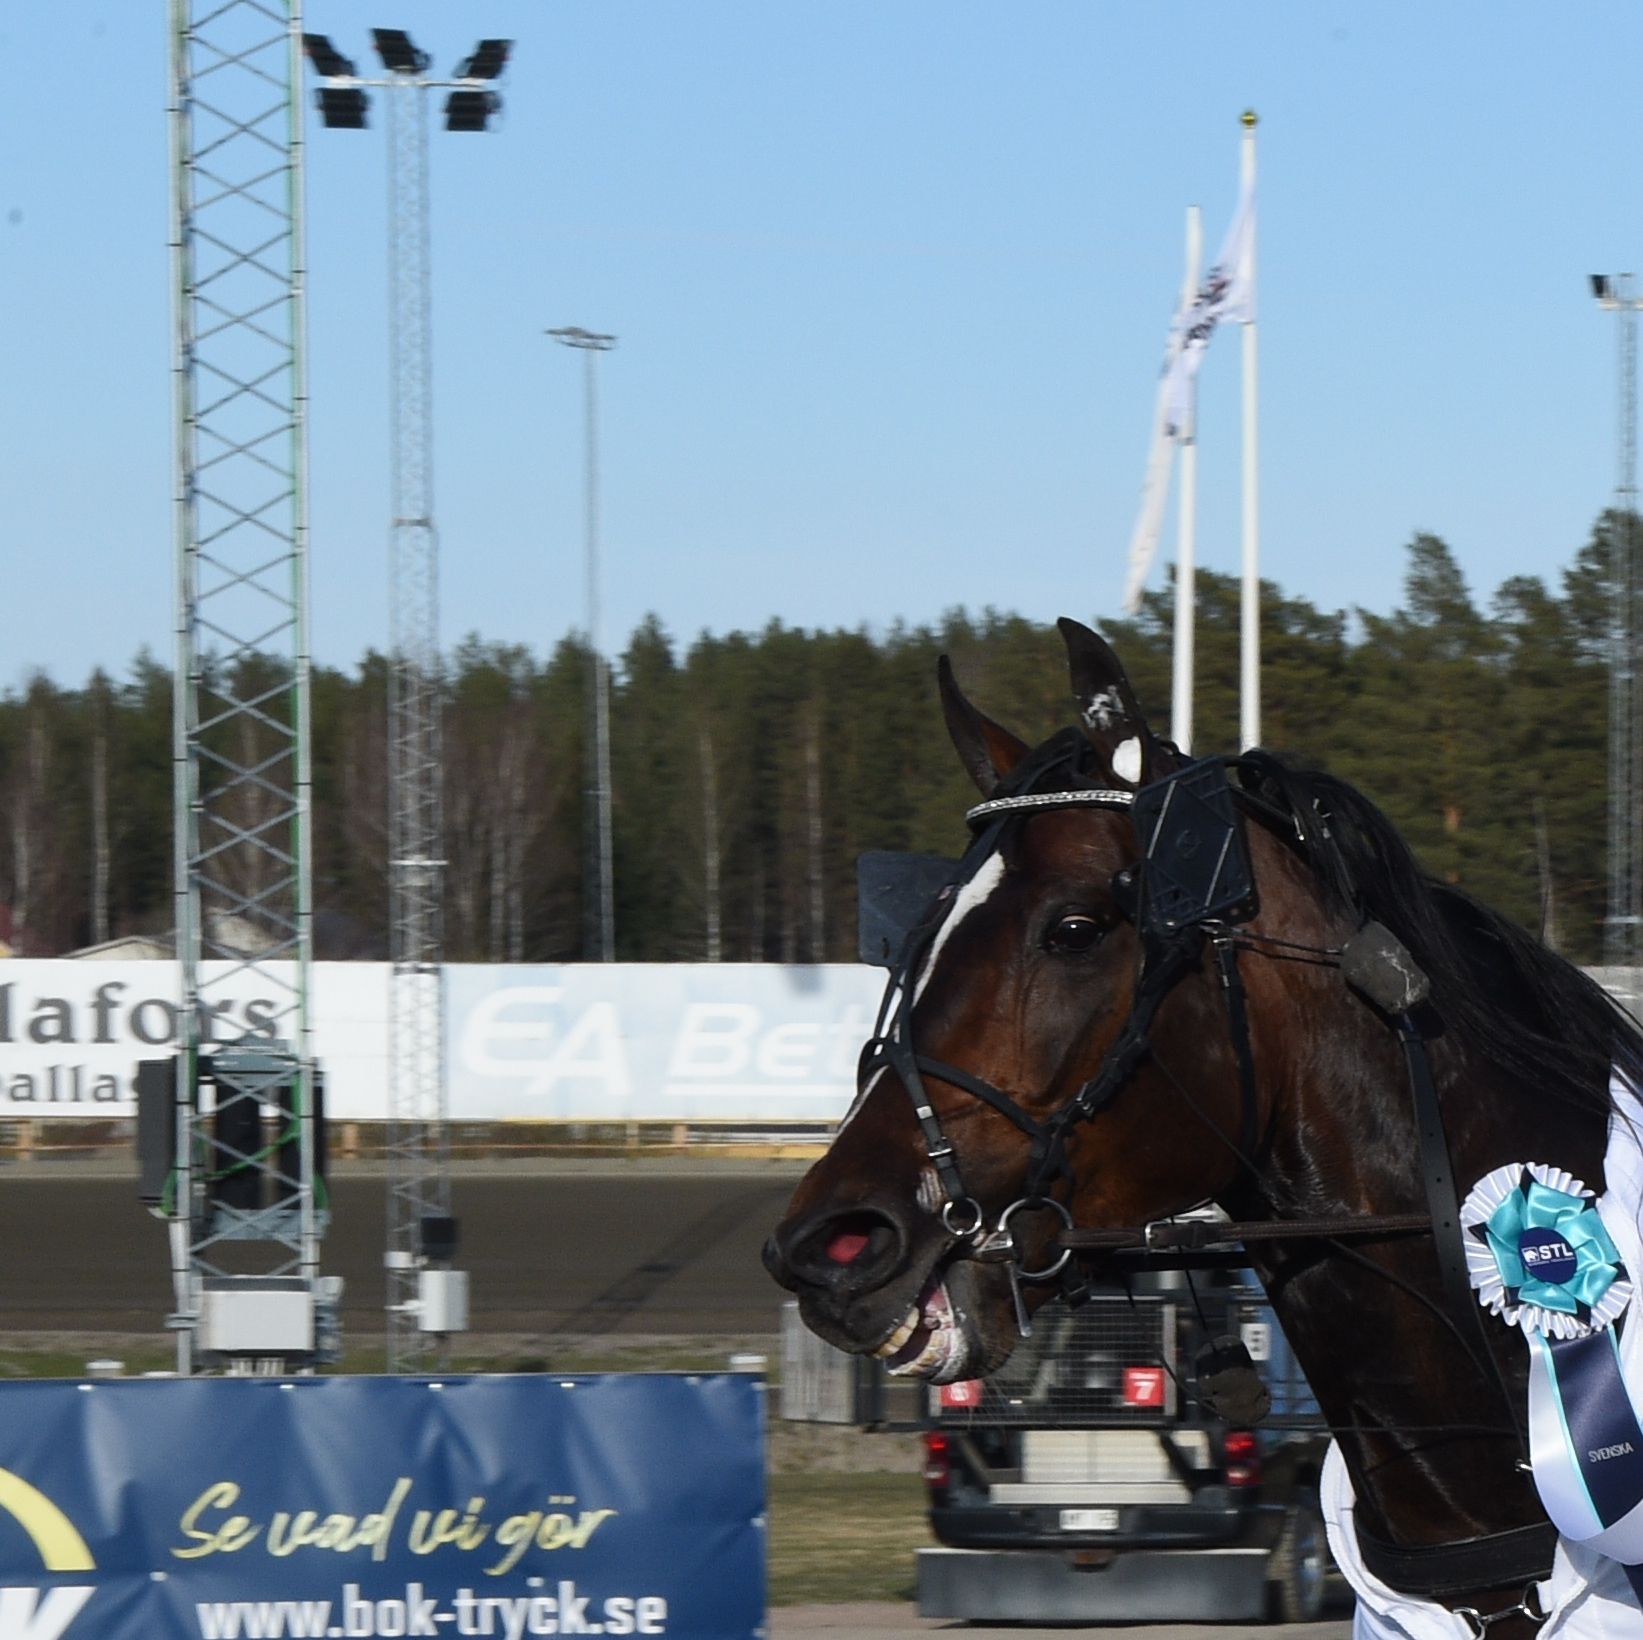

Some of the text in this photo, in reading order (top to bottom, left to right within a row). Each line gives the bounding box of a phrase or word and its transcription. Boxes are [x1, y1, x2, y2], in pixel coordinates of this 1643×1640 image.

[1538, 1243, 1575, 1260] STL
[1133, 1381, 1157, 1401] 7
[1588, 1441, 1635, 1463] SVENSKA
[170, 1477, 619, 1577] Se vad vi gör
